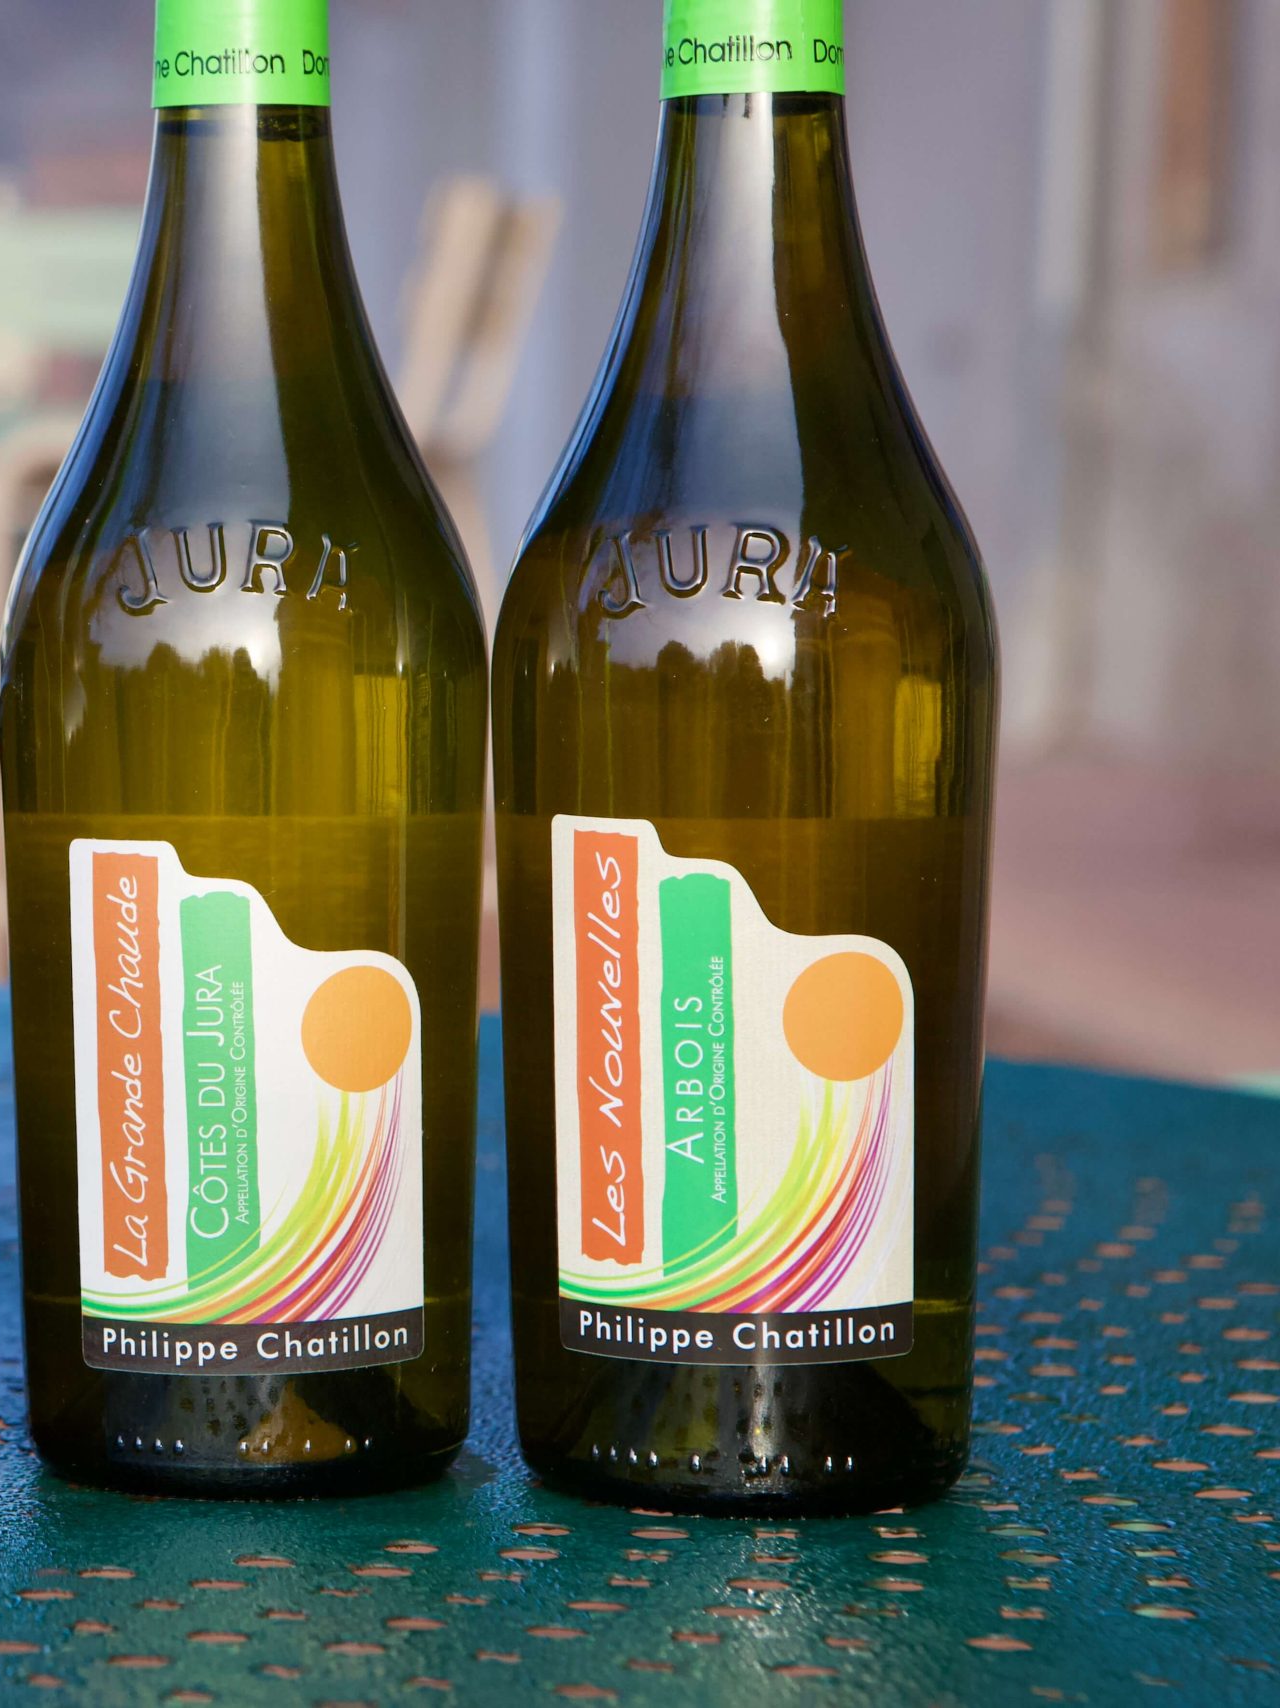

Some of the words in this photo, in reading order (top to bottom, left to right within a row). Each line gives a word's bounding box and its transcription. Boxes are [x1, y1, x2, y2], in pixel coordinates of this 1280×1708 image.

[175, 49, 285, 77] Chatillon
[678, 35, 792, 65] Chatillon
[120, 519, 358, 617] JURA
[597, 523, 847, 620] JURA
[109, 875, 142, 1039] Chaude
[587, 851, 622, 1127] Nouvelles
[706, 956, 724, 1036] CONTRÔLÉE
[186, 964, 223, 1047] JURA
[230, 982, 246, 1060] CONTRÔLÉE
[198, 1060, 225, 1108] DU
[667, 996, 704, 1163] ARBOIS
[110, 1052, 148, 1204] Grande
[711, 1121, 726, 1203] APPELLATION
[191, 1123, 229, 1239] CÔTES
[236, 1141, 249, 1224] APPELLATION
[592, 1145, 627, 1246] Les
[114, 1216, 148, 1266] La
[103, 1327, 238, 1366] Philippe
[257, 1326, 408, 1359] Chatillon
[580, 1311, 713, 1353] Philippe
[733, 1317, 894, 1348] Chatillon
